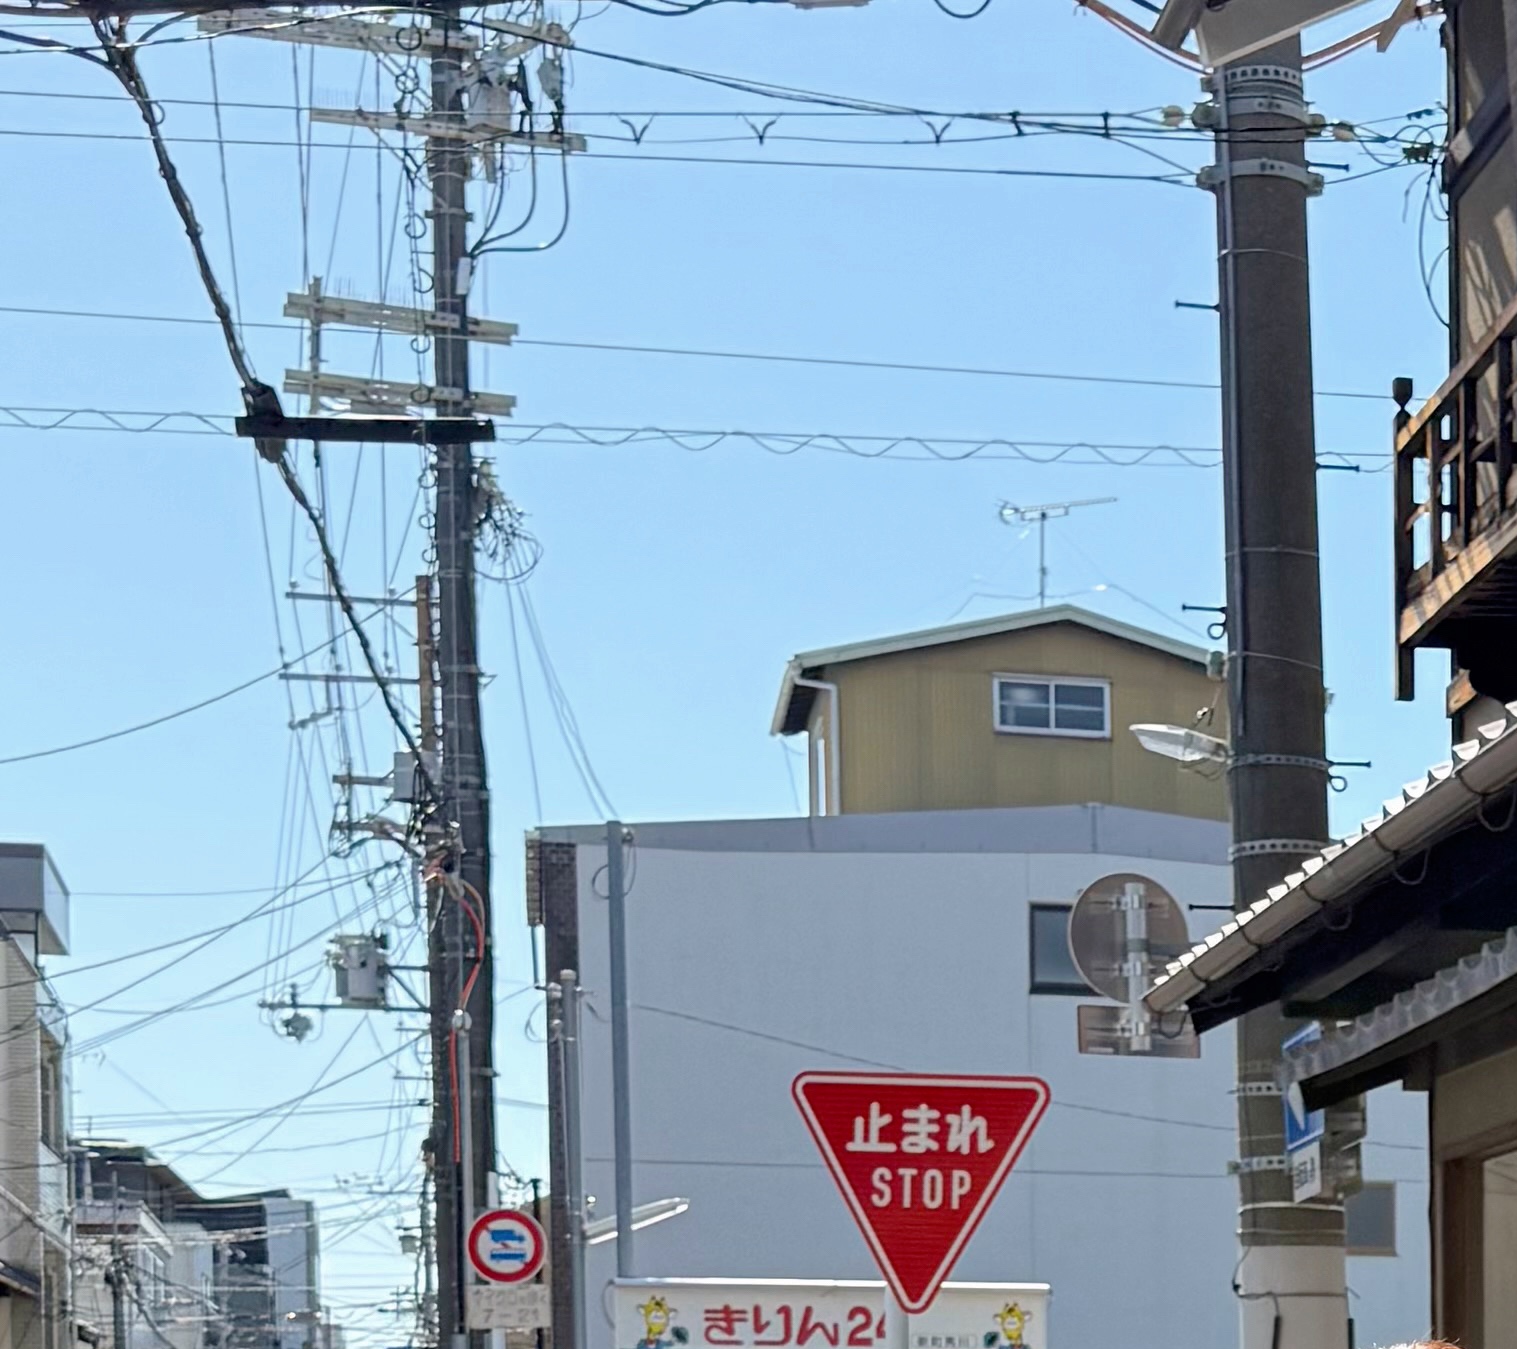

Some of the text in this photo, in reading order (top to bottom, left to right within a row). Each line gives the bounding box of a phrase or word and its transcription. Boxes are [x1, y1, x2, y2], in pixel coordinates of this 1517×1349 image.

[845, 1101, 995, 1155] 止まれ
[870, 1166, 972, 1210] STOP
